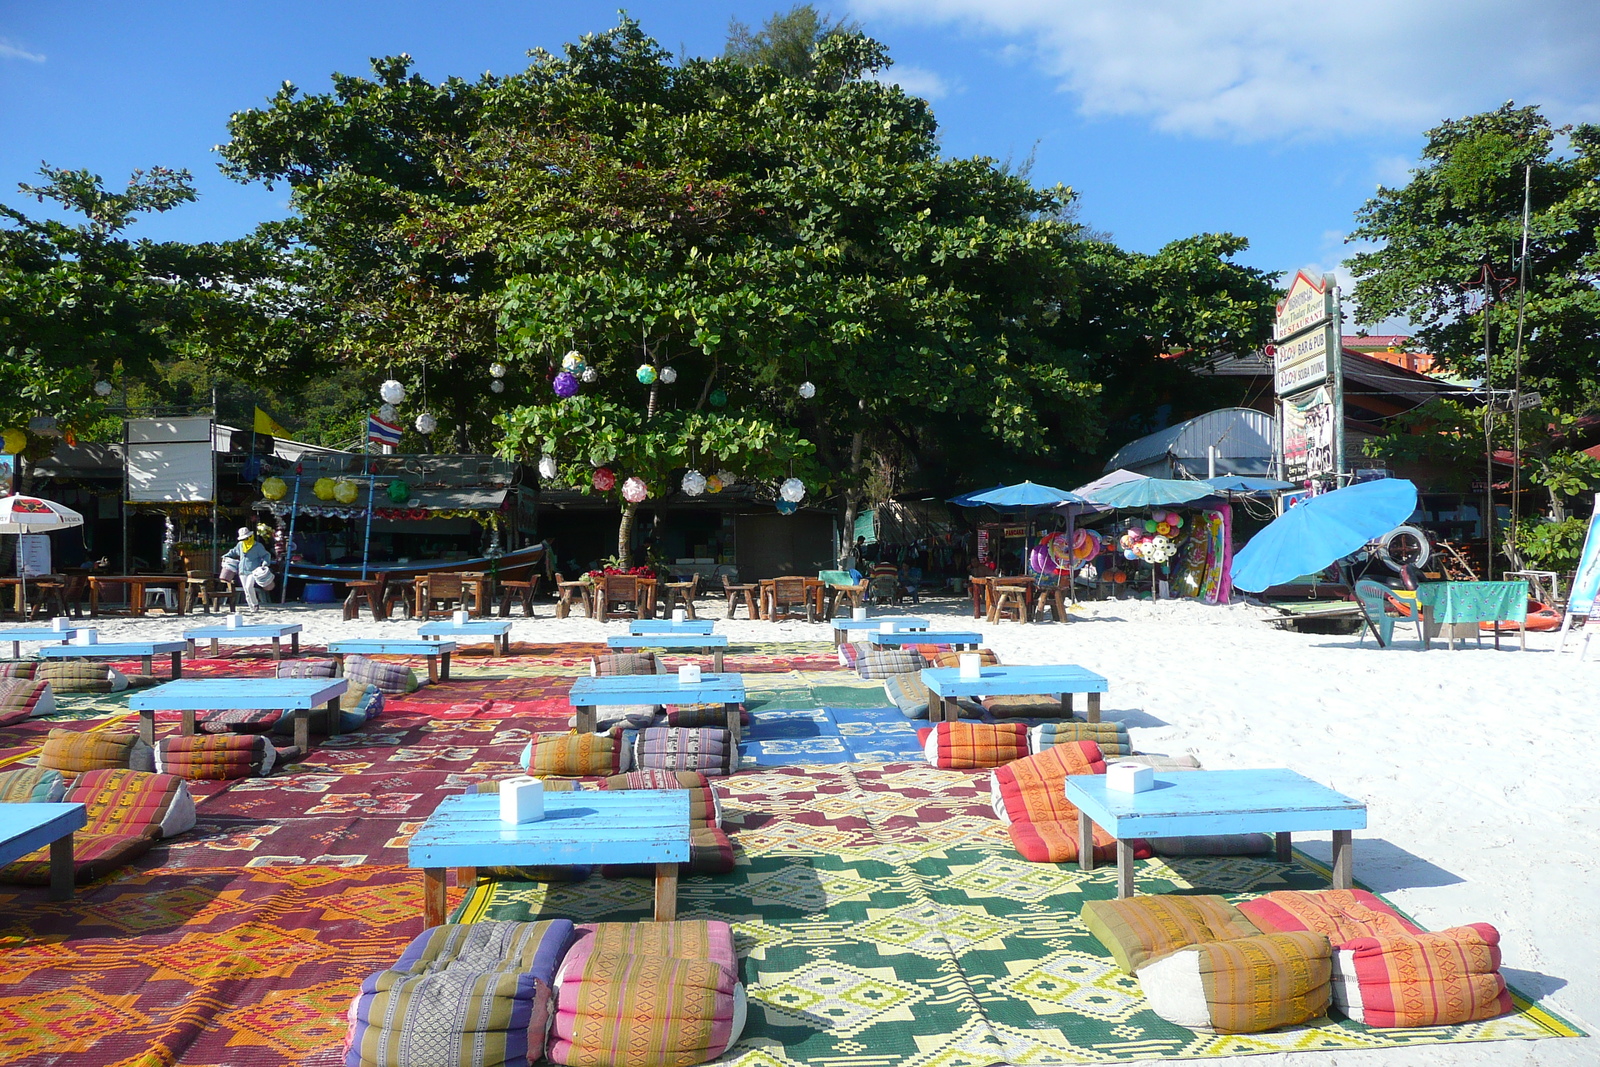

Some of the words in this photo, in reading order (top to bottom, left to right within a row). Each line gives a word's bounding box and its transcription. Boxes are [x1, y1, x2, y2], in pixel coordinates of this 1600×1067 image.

[1279, 310, 1323, 337] RESTAURANT
[1298, 341, 1308, 355] BAR
[1309, 338, 1313, 351] &
[1313, 333, 1324, 349] PUB
[1297, 367, 1309, 381] SCUBA
[1310, 360, 1324, 375] DIVING
